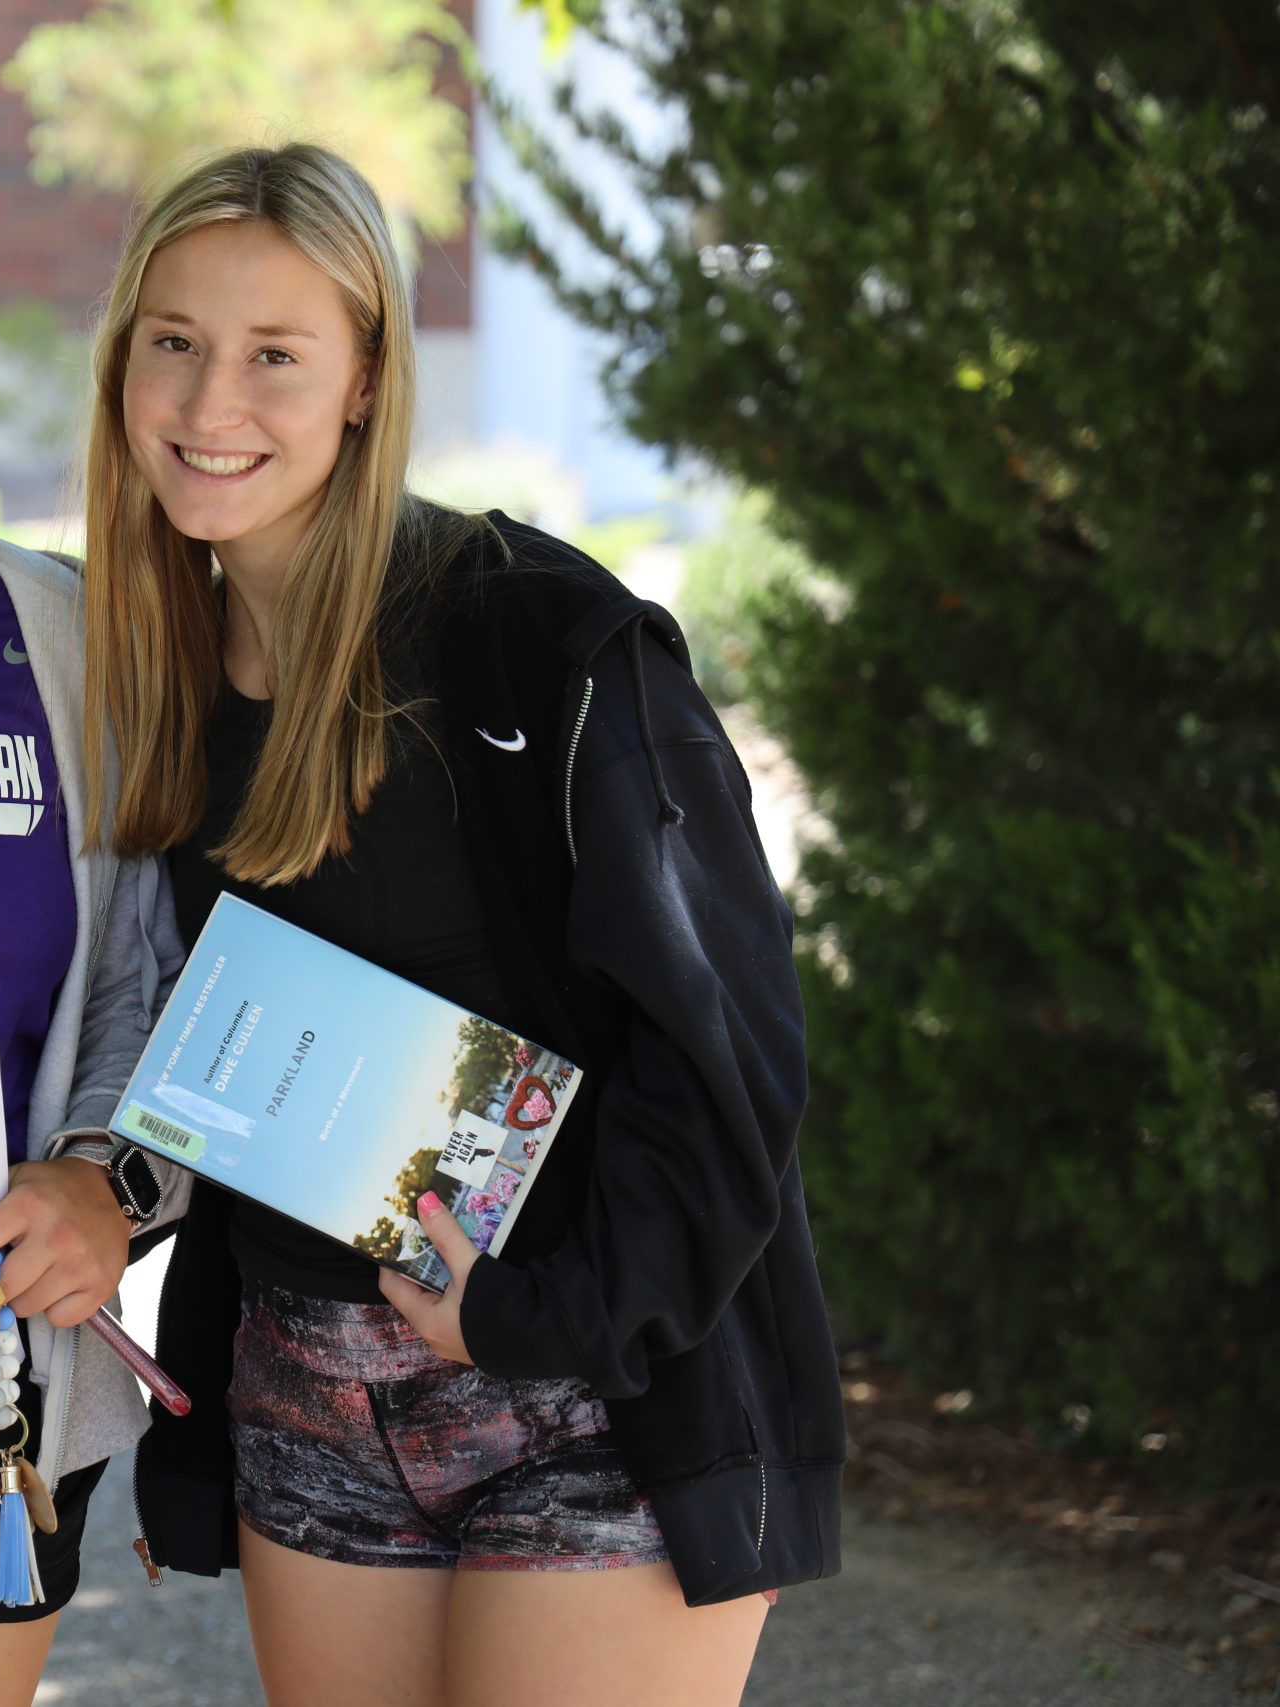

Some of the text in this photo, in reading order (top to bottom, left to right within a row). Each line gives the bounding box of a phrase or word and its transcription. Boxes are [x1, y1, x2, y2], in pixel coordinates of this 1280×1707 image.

[166, 1044, 183, 1071] YORK
[178, 1015, 197, 1044] TIMES
[193, 955, 227, 1015] BESTSELLER
[204, 1000, 249, 1084] Author of Columbine
[215, 1004, 264, 1092] DAVE CULLEN
[265, 1030, 315, 1117] PARKLAND
[319, 1120, 335, 1141] Birth
[441, 1131, 464, 1164] NEVER
[456, 1131, 478, 1163] AGAIN
